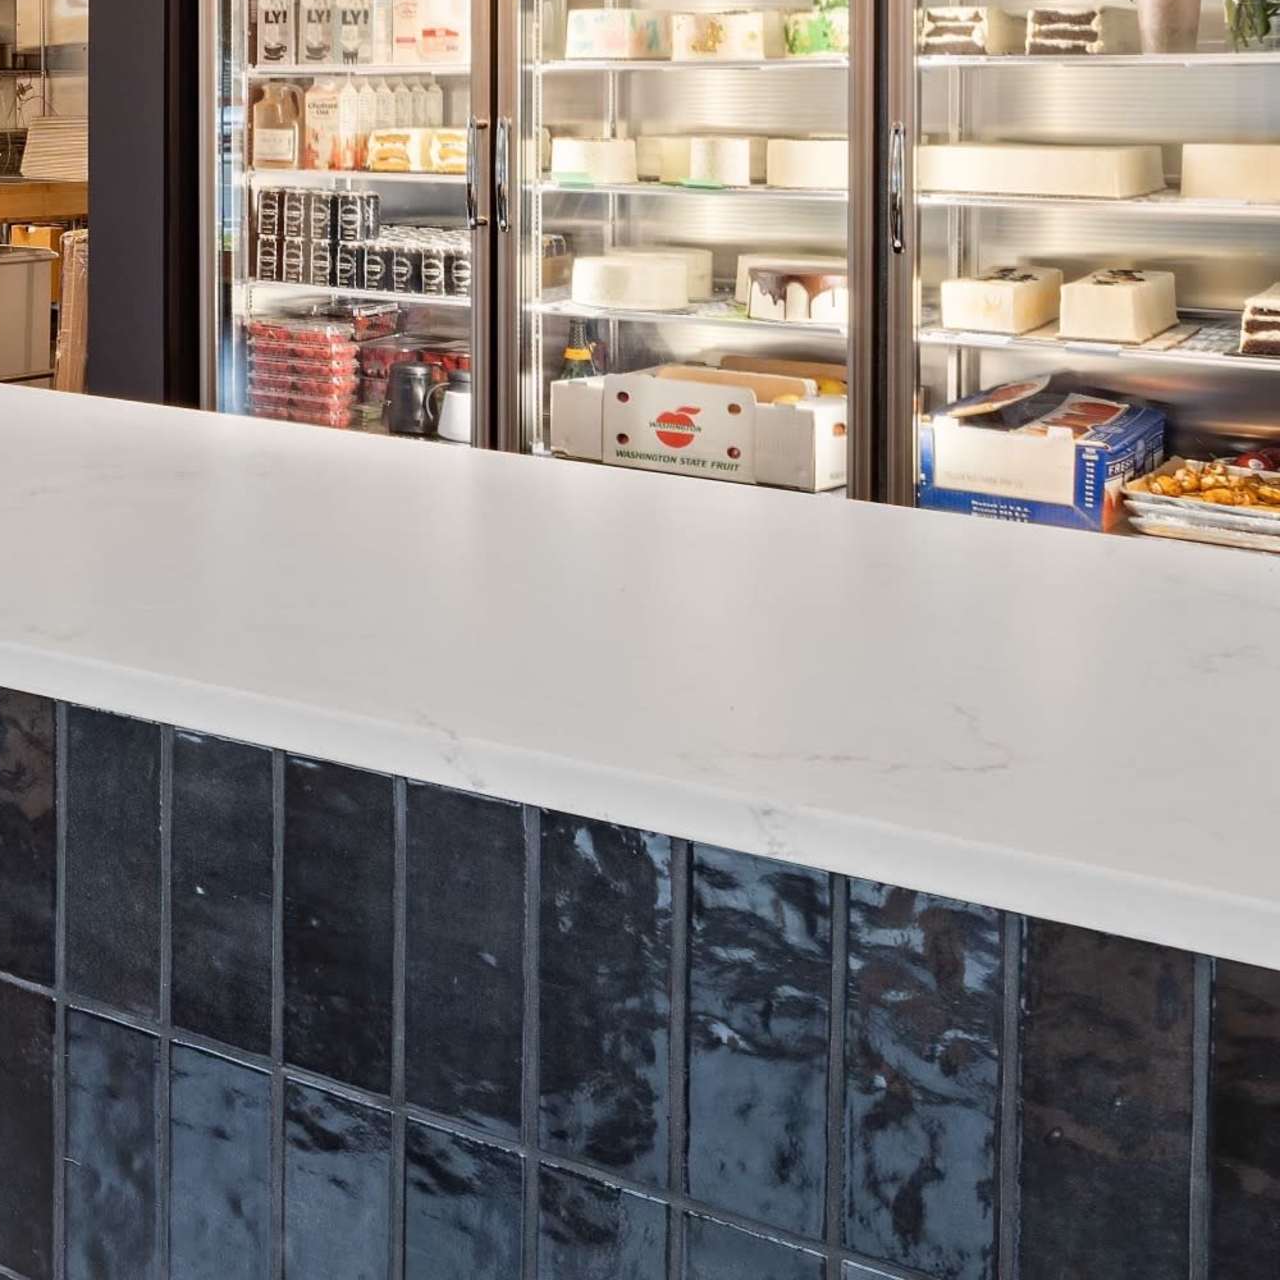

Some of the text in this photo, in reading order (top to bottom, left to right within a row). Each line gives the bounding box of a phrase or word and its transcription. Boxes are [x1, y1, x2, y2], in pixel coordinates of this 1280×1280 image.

[264, 8, 287, 24] LY!
[306, 8, 331, 24] LY!
[341, 8, 369, 25] LY!
[648, 421, 702, 432] WASHINGTON
[615, 449, 741, 471] WASHINGTON STATE FRUIT
